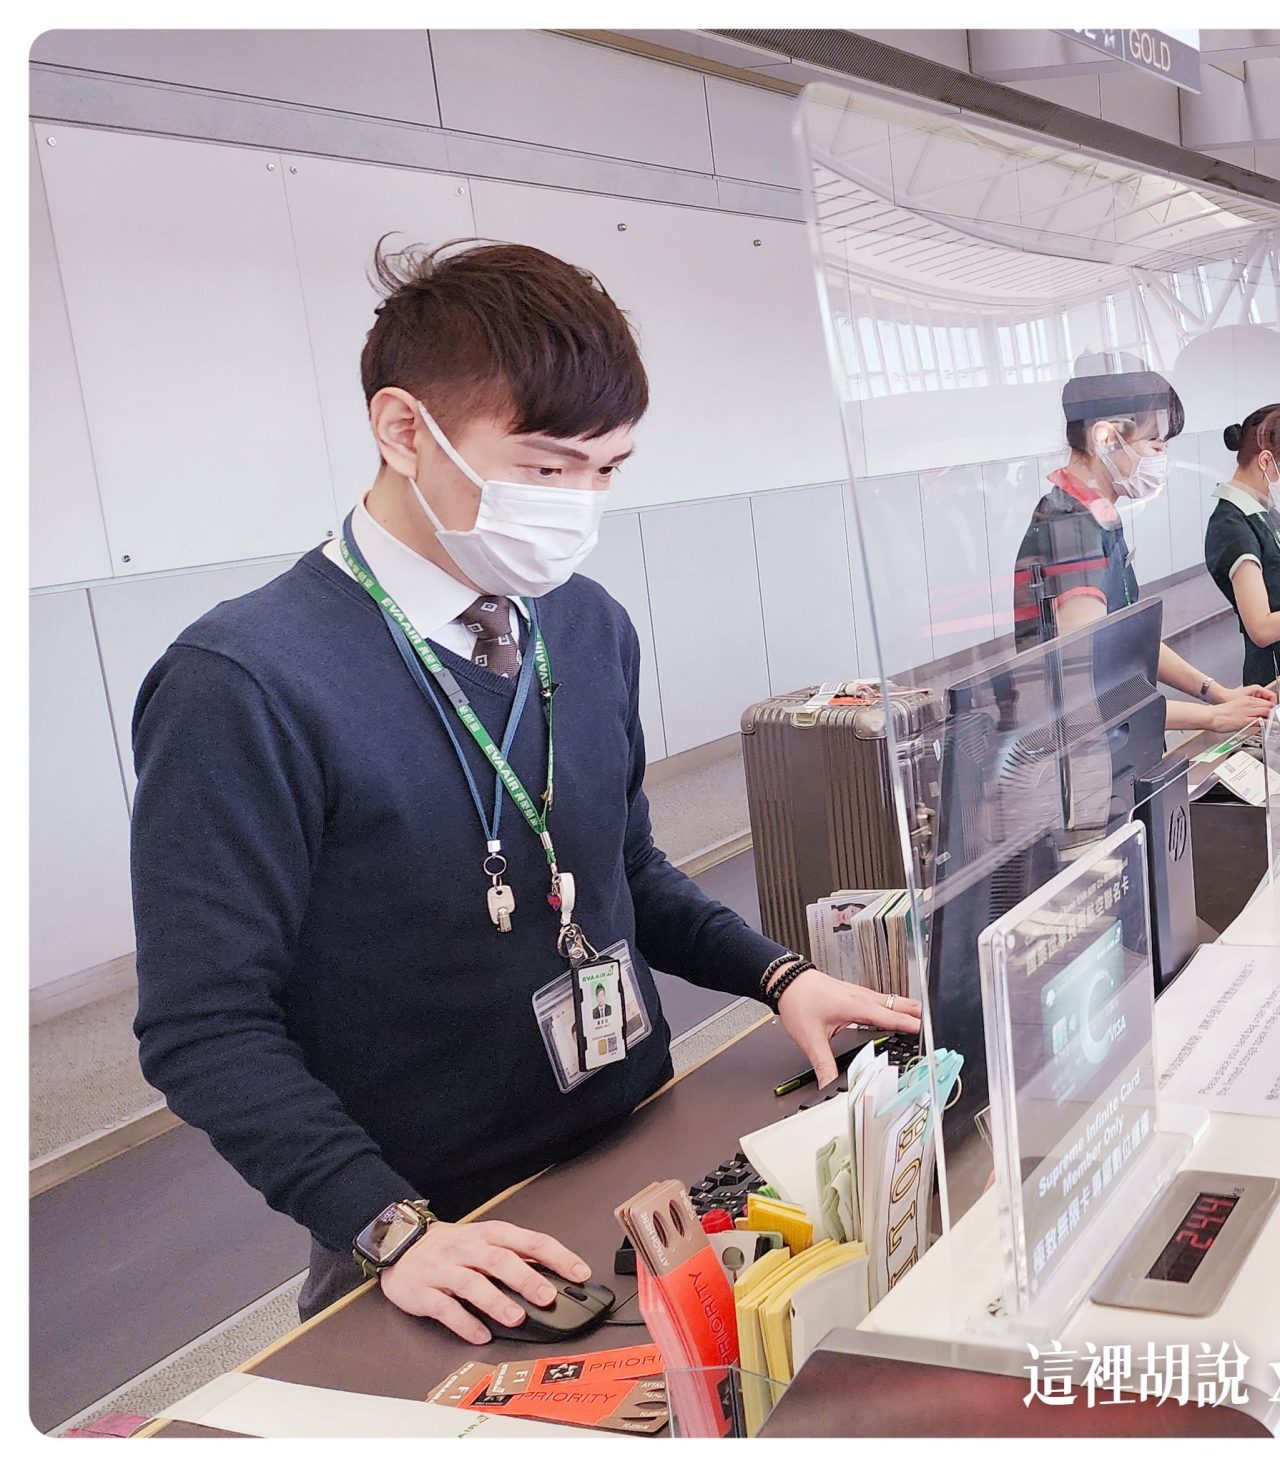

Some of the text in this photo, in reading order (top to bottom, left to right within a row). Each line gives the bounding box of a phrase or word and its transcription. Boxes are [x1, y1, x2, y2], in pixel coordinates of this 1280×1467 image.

[1129, 29, 1171, 72] GOLD
[485, 743, 505, 769] EVA
[500, 768, 520, 791] AIR
[1109, 1015, 1126, 1043] VISA
[1038, 1068, 1141, 1198] Supreme Infinite Card
[1062, 1114, 1124, 1197] Member Only
[640, 1210, 671, 1268] ATTACH HERE
[688, 1271, 733, 1366] PRIORITY
[448, 1386, 471, 1400] F1
[513, 1370, 529, 1383] F1
[516, 1391, 617, 1404] PRIORITY
